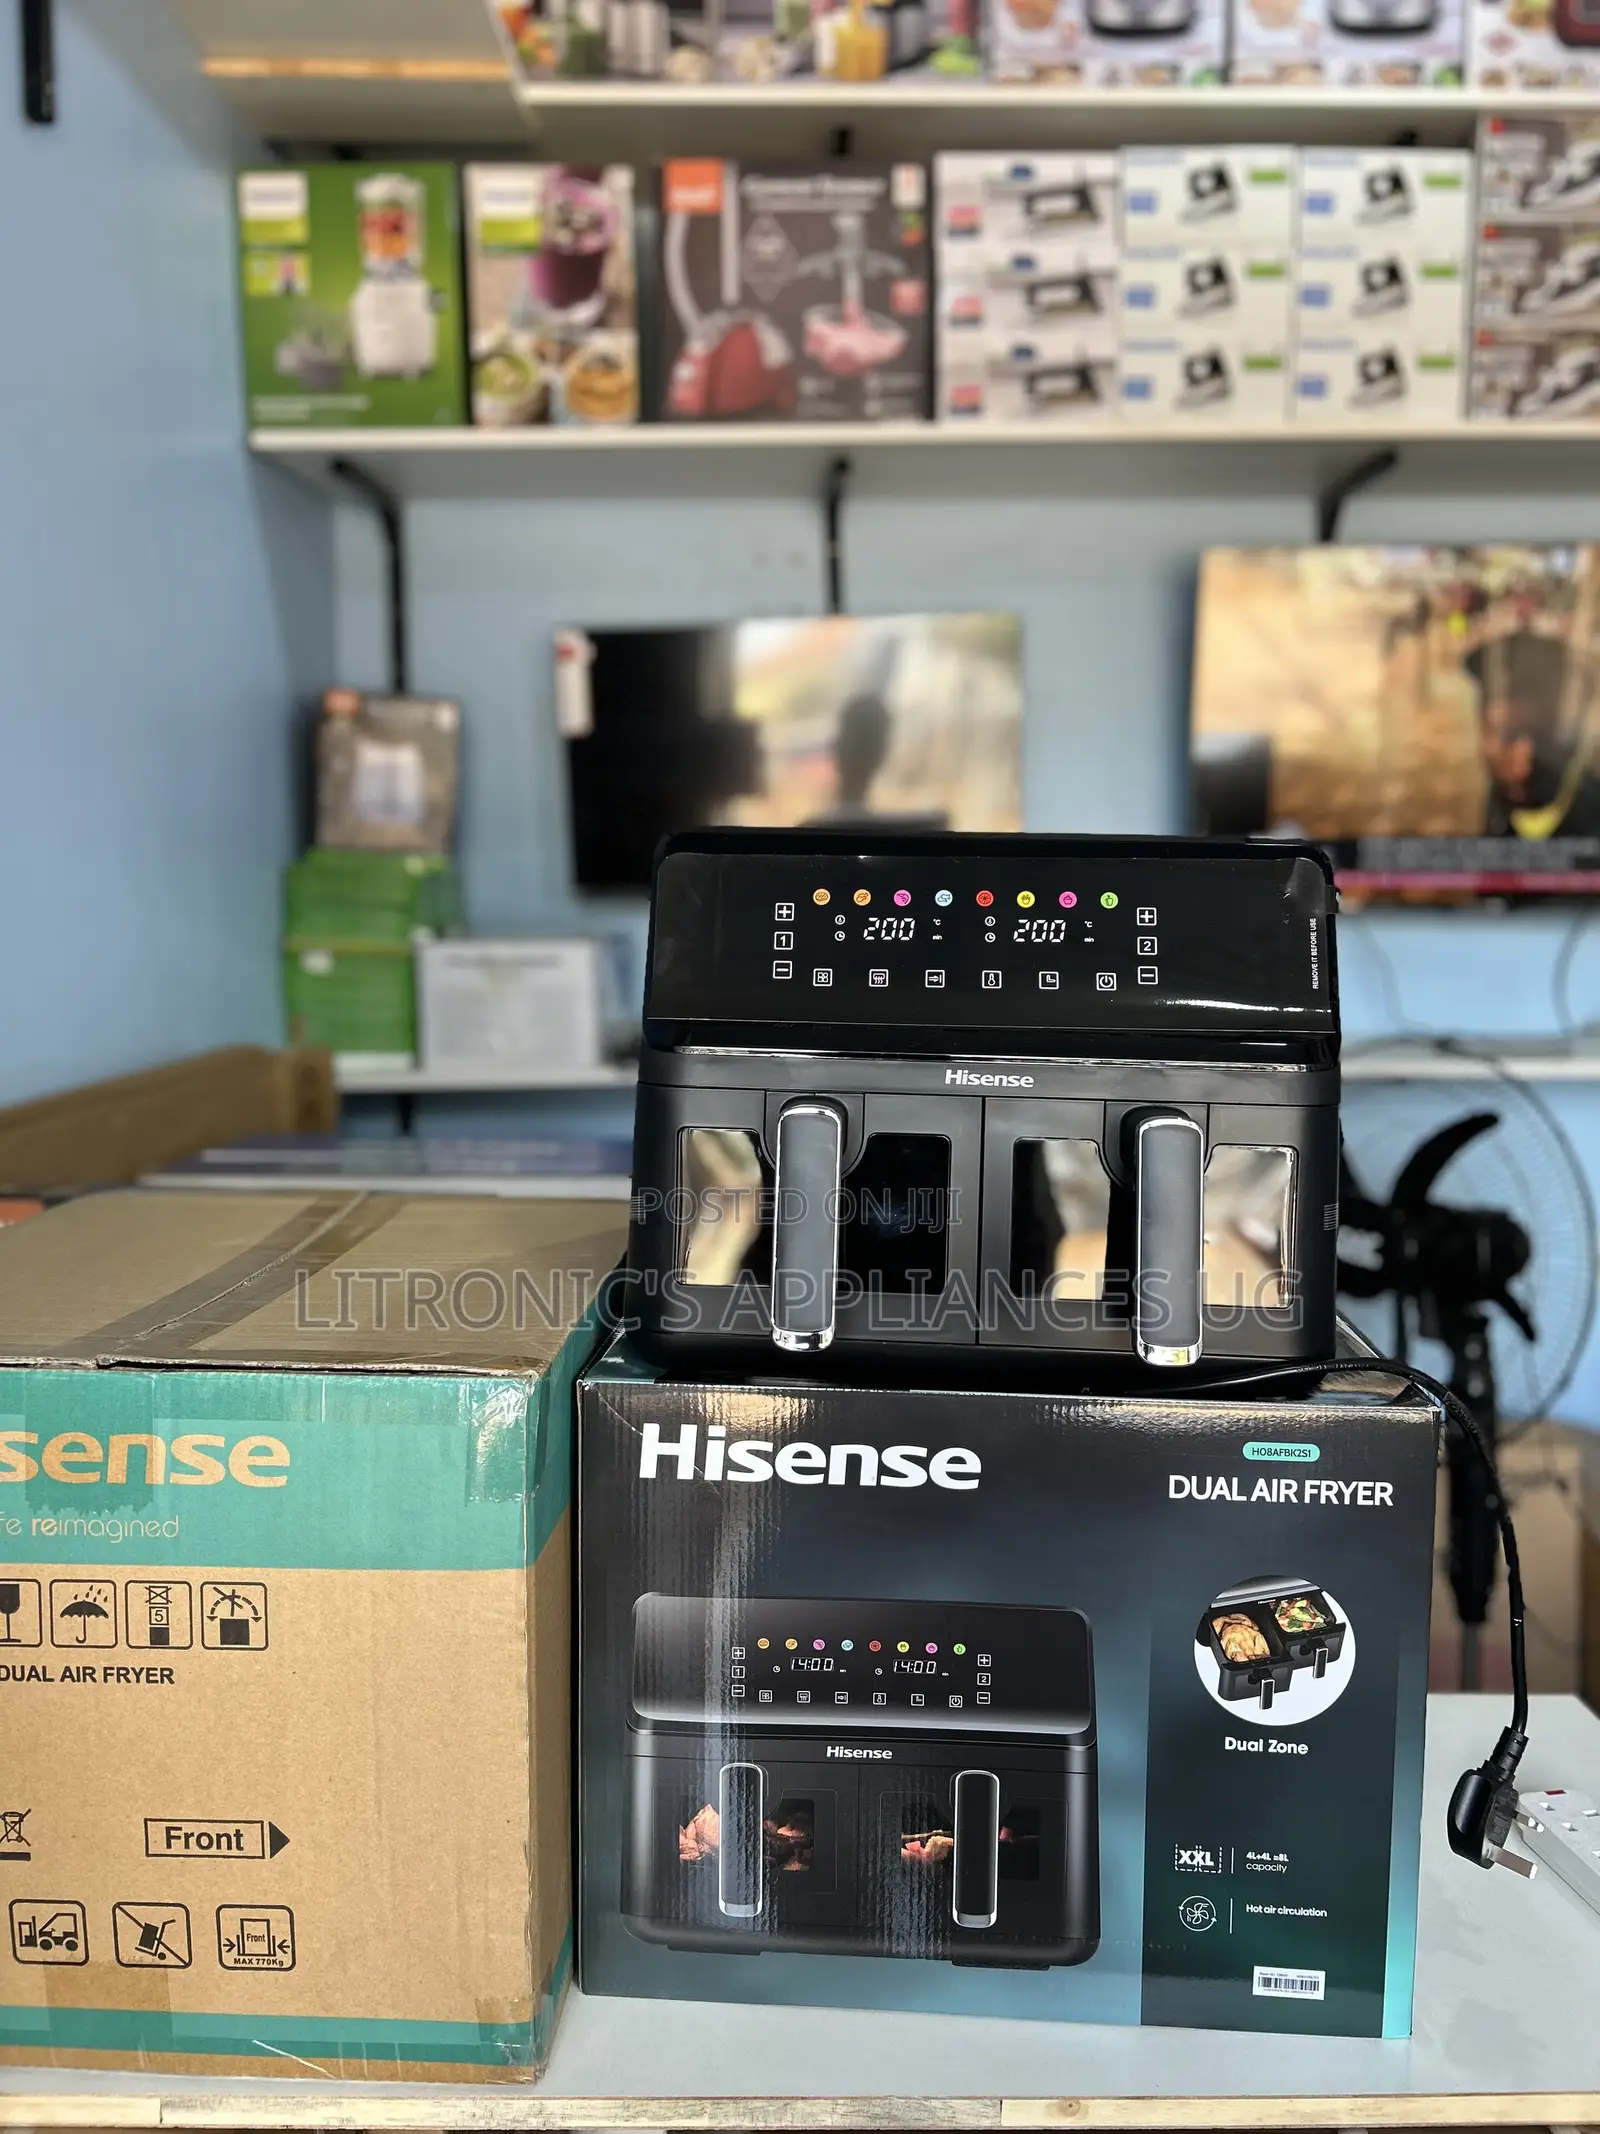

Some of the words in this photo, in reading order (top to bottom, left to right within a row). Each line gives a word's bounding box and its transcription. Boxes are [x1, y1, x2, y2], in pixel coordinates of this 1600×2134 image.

[863, 917, 915, 941] 200
[1013, 919, 1066, 943] 200
[1309, 917, 1317, 931] USE
[1310, 931, 1318, 956] BEFORE
[1311, 963, 1319, 990] REMOVE
[944, 1068, 1035, 1088] Hisense
[0, 1431, 291, 1488] sense
[639, 1422, 982, 1490] Hisense
[1168, 1474, 1248, 1501] DUAL
[1250, 1477, 1299, 1504] AIR
[1304, 1479, 1394, 1507] FRYER
[32, 1515, 179, 1544] reimagined
[154, 1609, 164, 1623] 5
[0, 1664, 55, 1683] DUAL
[59, 1665, 97, 1684] AIR
[103, 1667, 175, 1685] FRYER
[826, 1745, 893, 1760] Hisense
[1225, 1736, 1264, 1752] Dual
[1268, 1739, 1309, 1755] Zone
[165, 1826, 244, 1851] Front
[1178, 1849, 1215, 1867] XXL
[1246, 1863, 1288, 1874] capacity
[1246, 1904, 1262, 1913] Hot
[1264, 1905, 1277, 1914] air
[1277, 1905, 1328, 1917] circulation
[246, 1933, 266, 1942] Front
[233, 1957, 254, 1965] MAX
[256, 1958, 284, 1967] 770Kg
